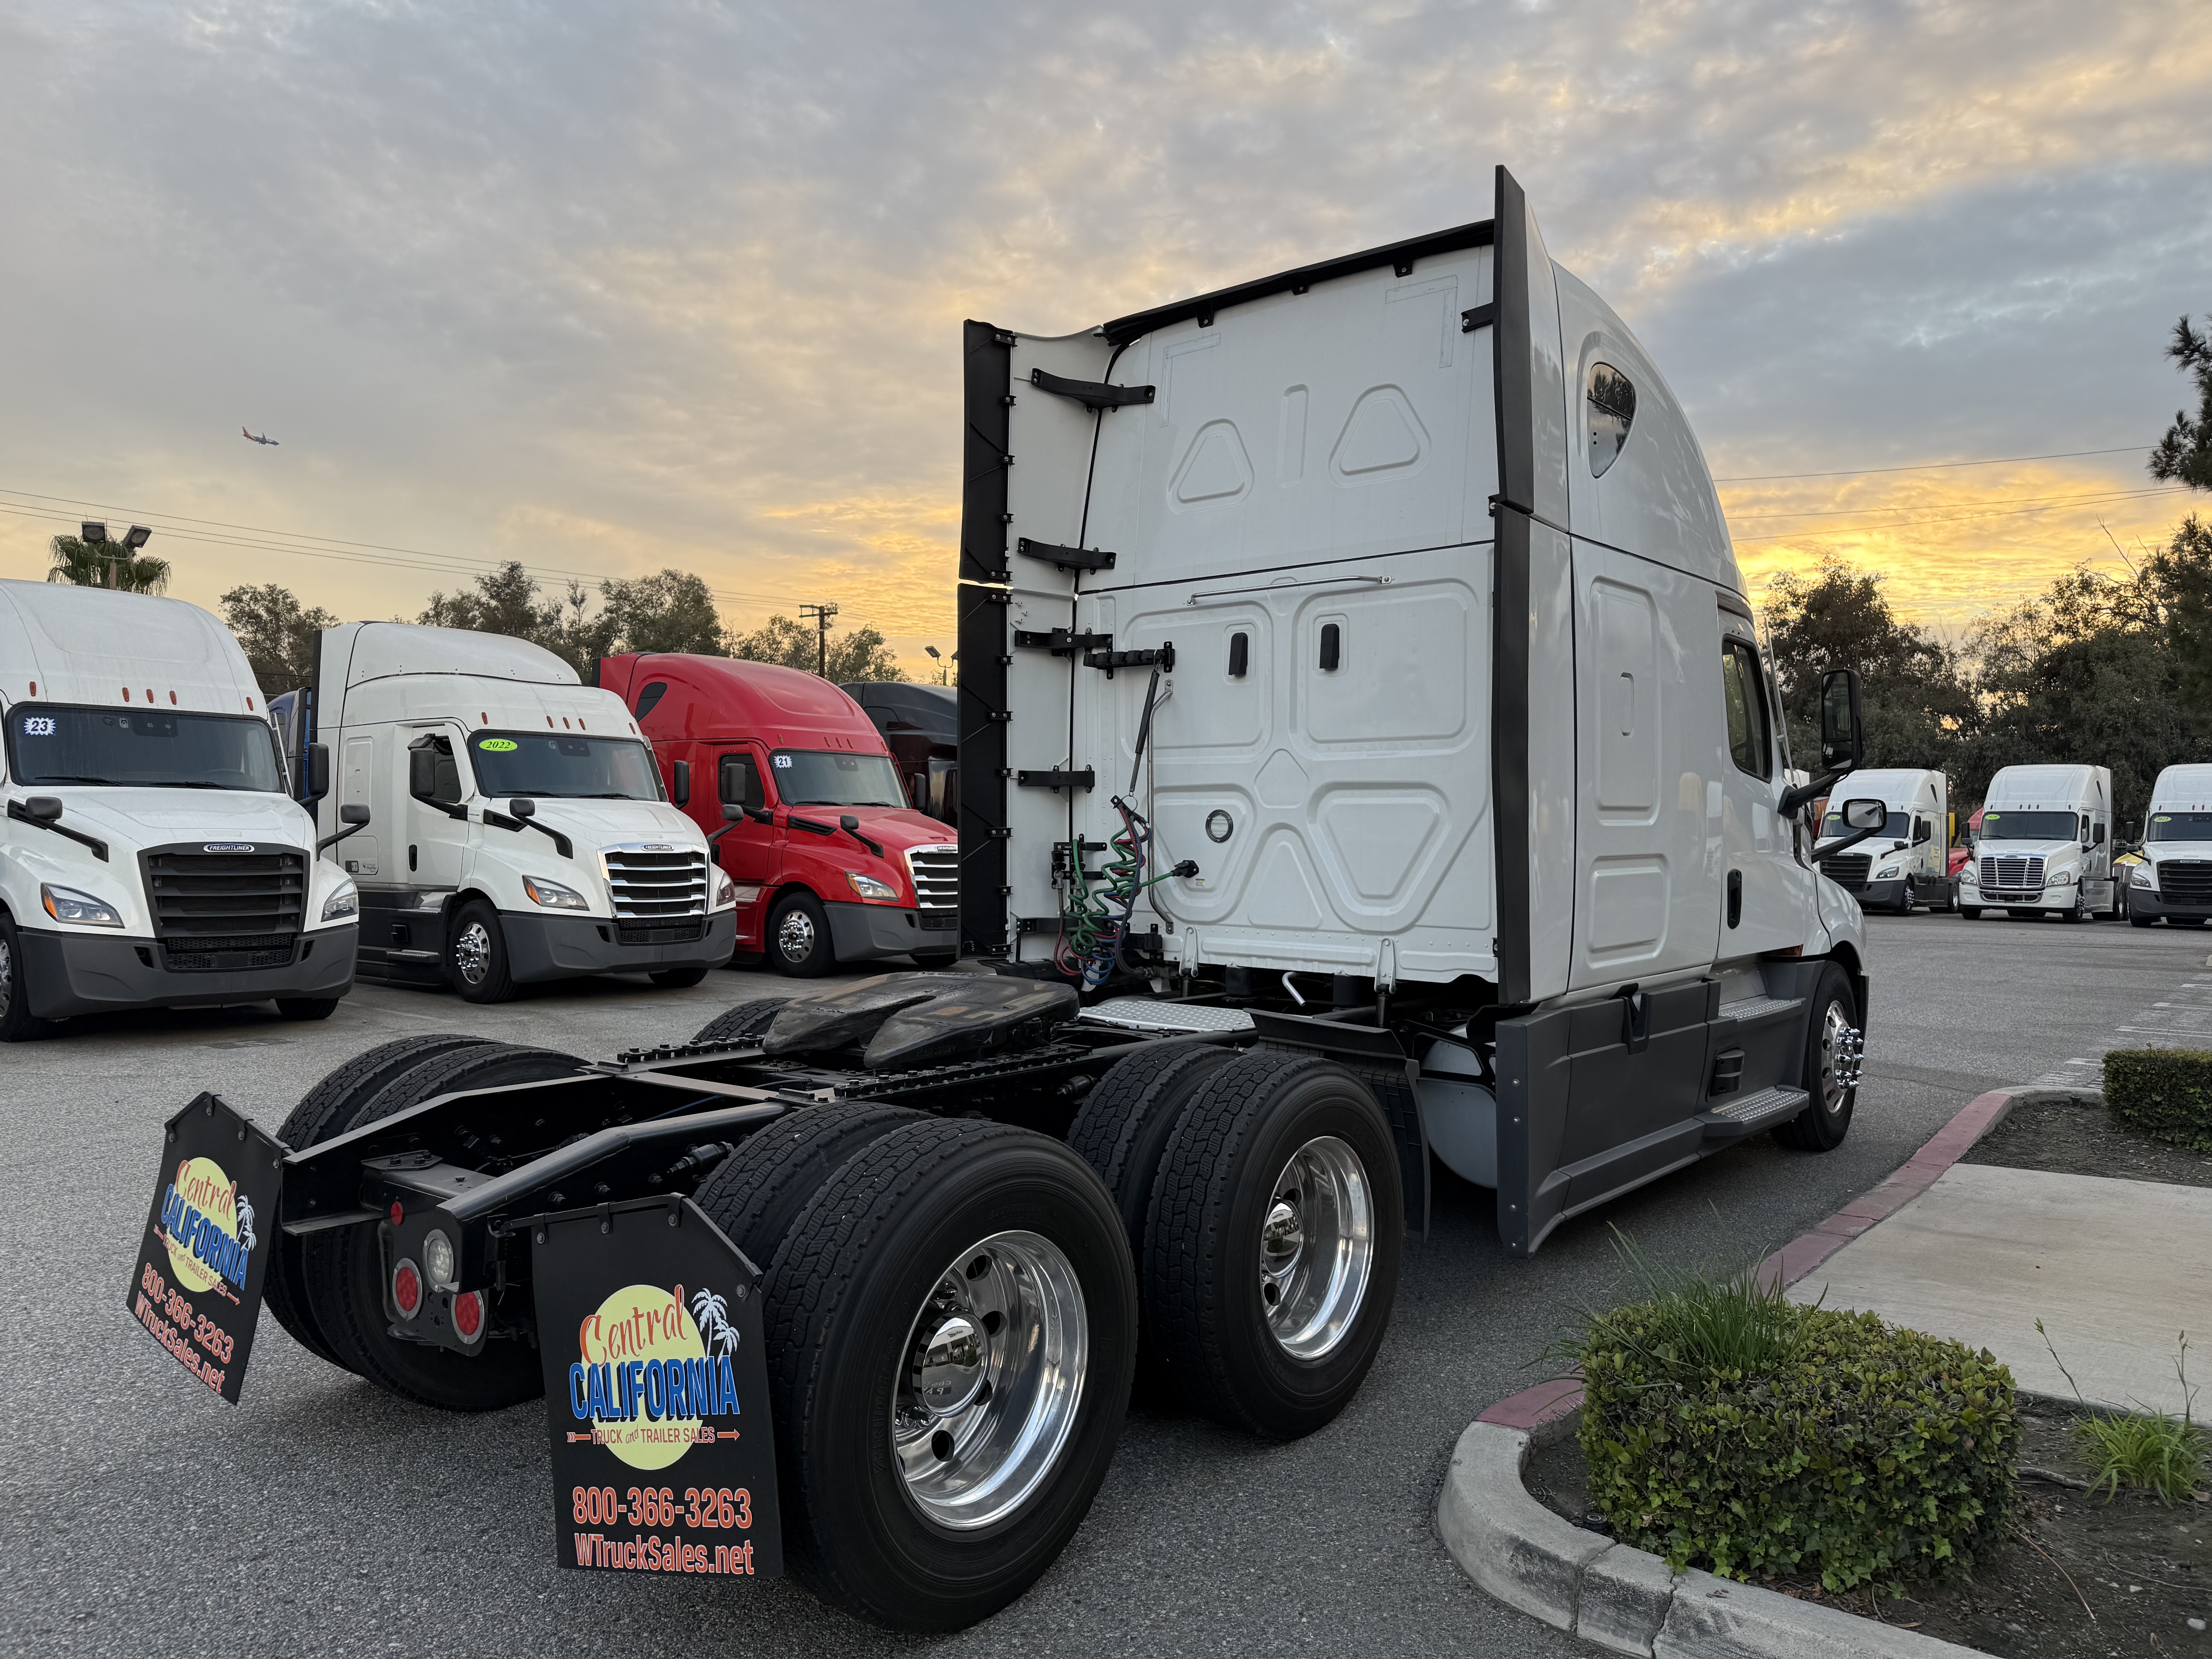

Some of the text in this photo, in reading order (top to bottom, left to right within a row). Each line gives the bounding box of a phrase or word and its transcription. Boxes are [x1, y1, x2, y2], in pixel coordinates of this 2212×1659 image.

[31, 721, 48, 732] 23
[779, 757, 788, 766] 21
[176, 1160, 237, 1220] Central
[161, 1183, 248, 1291] CALIFORNIA
[163, 1234, 178, 1257] TRUCK
[185, 1257, 208, 1283] TRAILER
[208, 1275, 228, 1297] SALES
[135, 1291, 225, 1394] WTruckSales.net
[142, 1262, 234, 1364] 800-366-3263
[580, 1284, 687, 1367] Central
[570, 1355, 740, 1420] CALIFORNIA
[591, 1424, 715, 1444] TRUCK and TRAILER SALES
[573, 1486, 752, 1528] 800-366-3263
[574, 1533, 754, 1575] WTruckSales.net
